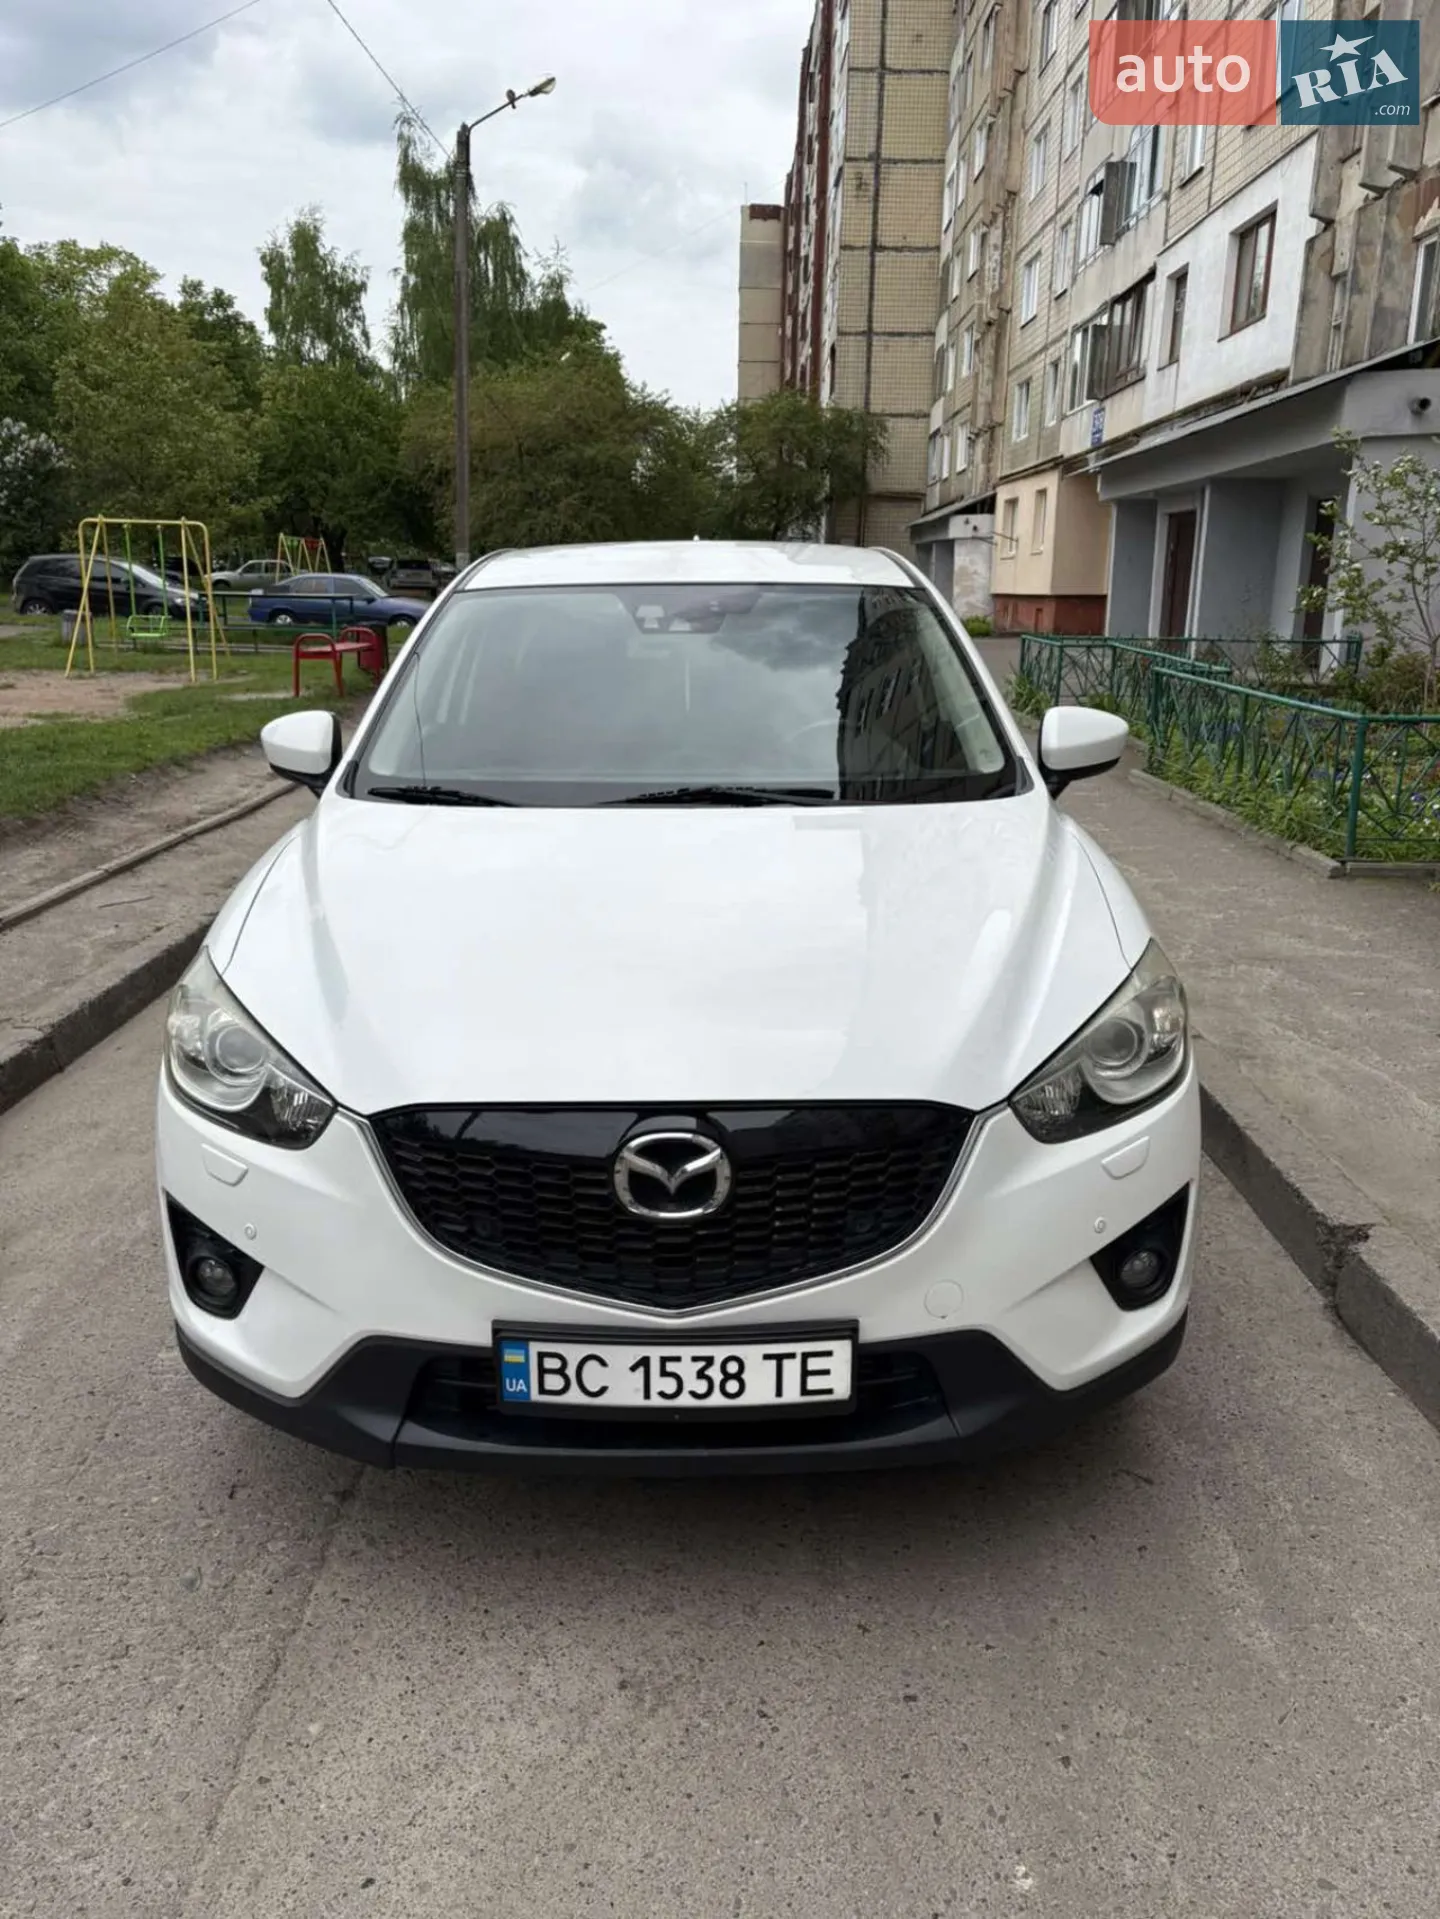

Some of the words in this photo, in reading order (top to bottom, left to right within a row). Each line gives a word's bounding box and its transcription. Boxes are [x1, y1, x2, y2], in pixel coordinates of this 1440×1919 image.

[506, 1378, 527, 1393] UA
[537, 1351, 609, 1398] BC
[629, 1355, 746, 1400] 1538
[763, 1351, 834, 1398] TE
